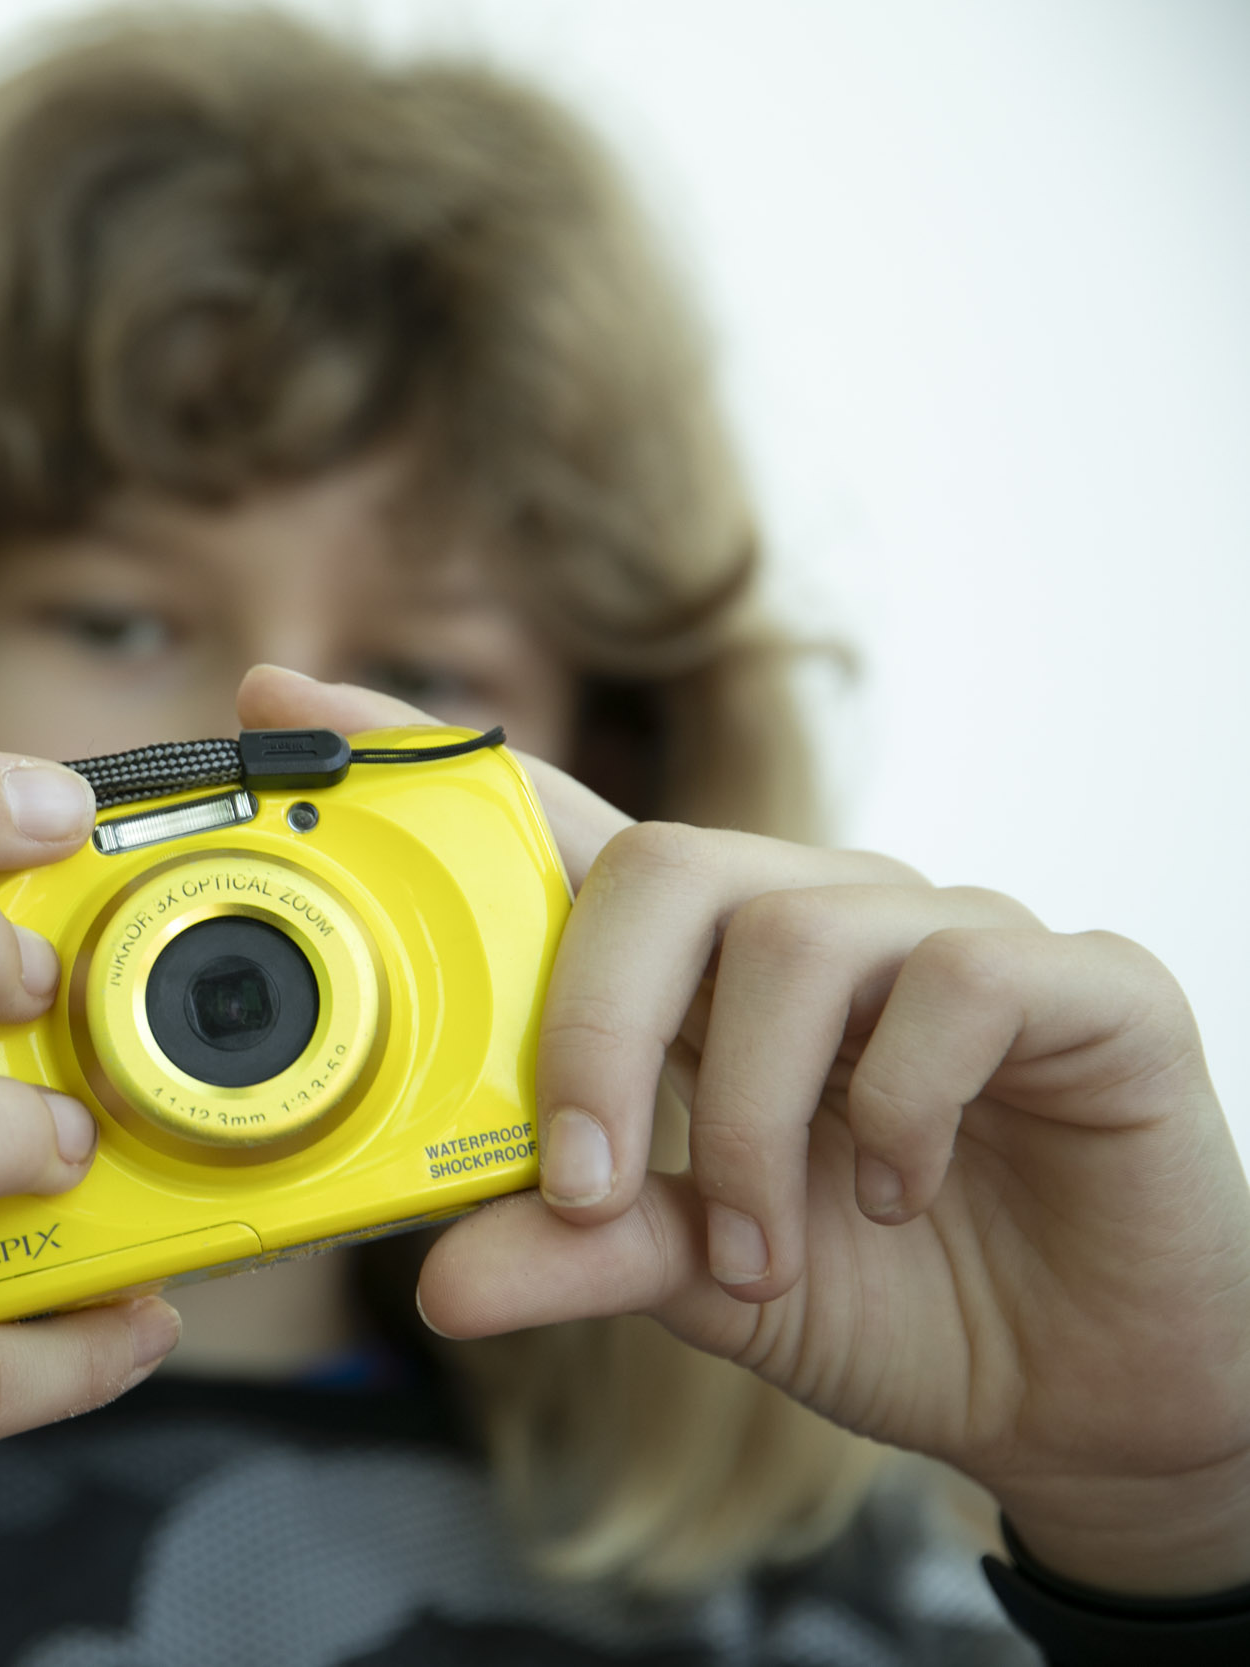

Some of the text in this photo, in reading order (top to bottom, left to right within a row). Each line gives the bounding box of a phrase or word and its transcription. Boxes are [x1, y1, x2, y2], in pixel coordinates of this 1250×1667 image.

[111, 873, 335, 986] NIKKOR 3X OPTICAL ZOOM
[152, 1087, 266, 1126] 41-123mm
[424, 1122, 532, 1159] WATERPROOF
[430, 1141, 537, 1179] SHOCKPROOF
